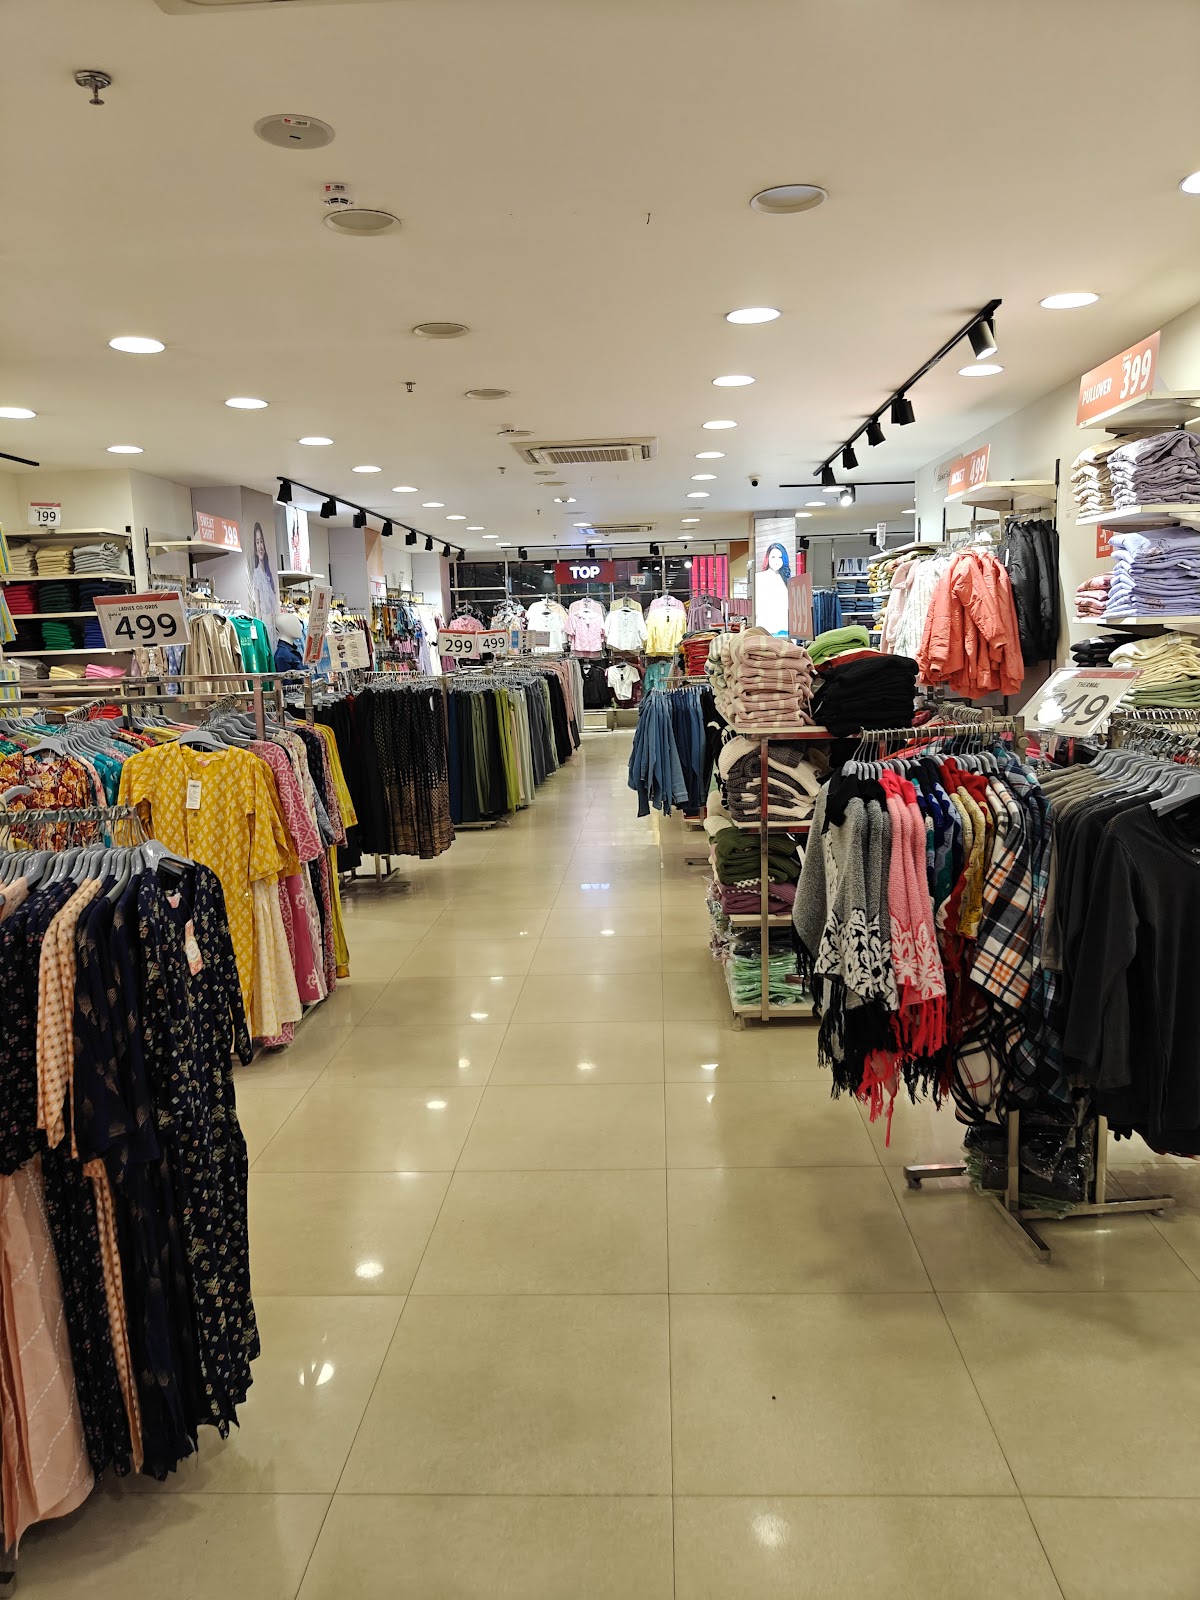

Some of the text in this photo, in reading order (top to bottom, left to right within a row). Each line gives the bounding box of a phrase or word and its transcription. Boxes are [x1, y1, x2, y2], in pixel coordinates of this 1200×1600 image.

[1082, 348, 1152, 406] PULLOVER 399
[970, 454, 986, 485] 499
[36, 510, 57, 522] 199
[200, 515, 215, 529] SWEAT
[223, 524, 239, 546] 299
[569, 565, 601, 580] TOP
[115, 613, 178, 640] 499
[445, 639, 473, 654] 299
[483, 637, 506, 649] 499
[1076, 681, 1101, 689] THERMAL
[1033, 693, 1110, 725] 49
